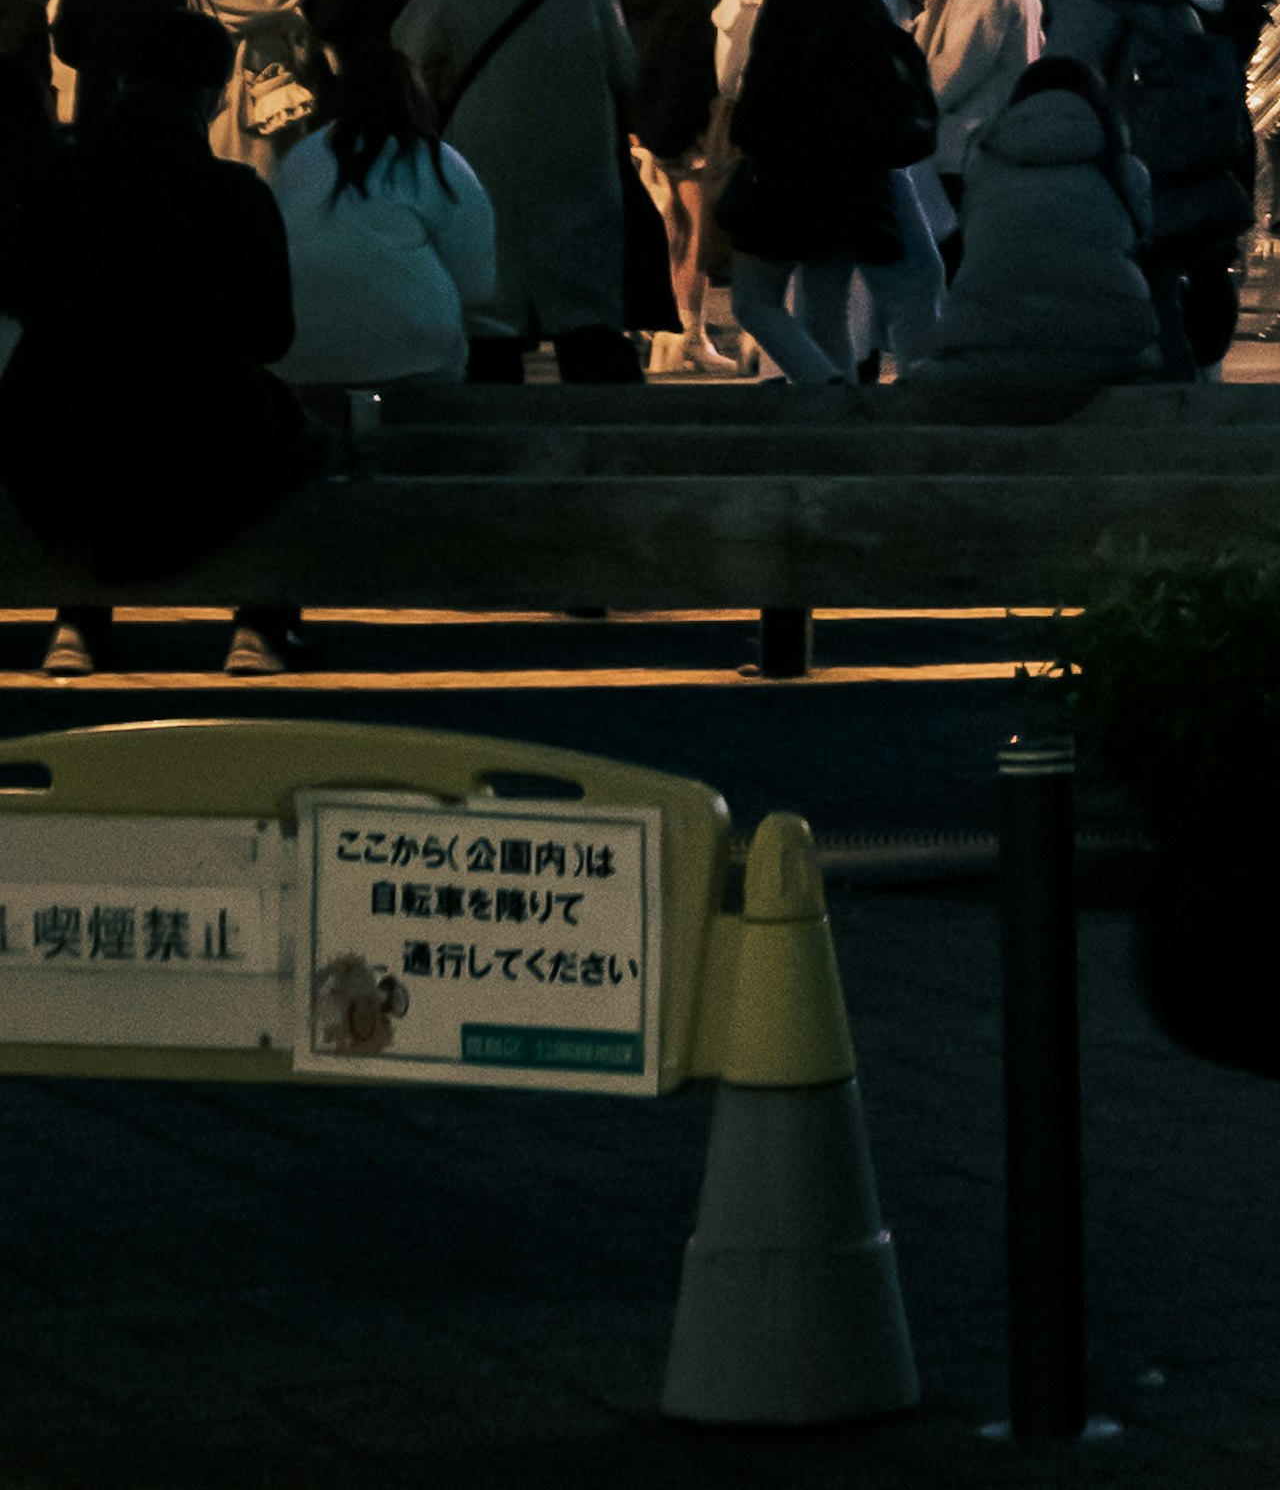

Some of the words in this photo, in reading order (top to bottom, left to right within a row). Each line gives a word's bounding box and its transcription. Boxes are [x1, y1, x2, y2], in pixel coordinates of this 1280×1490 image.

[370, 881, 586, 926] 自転車を降りて
[402, 940, 640, 986] 通行してください
